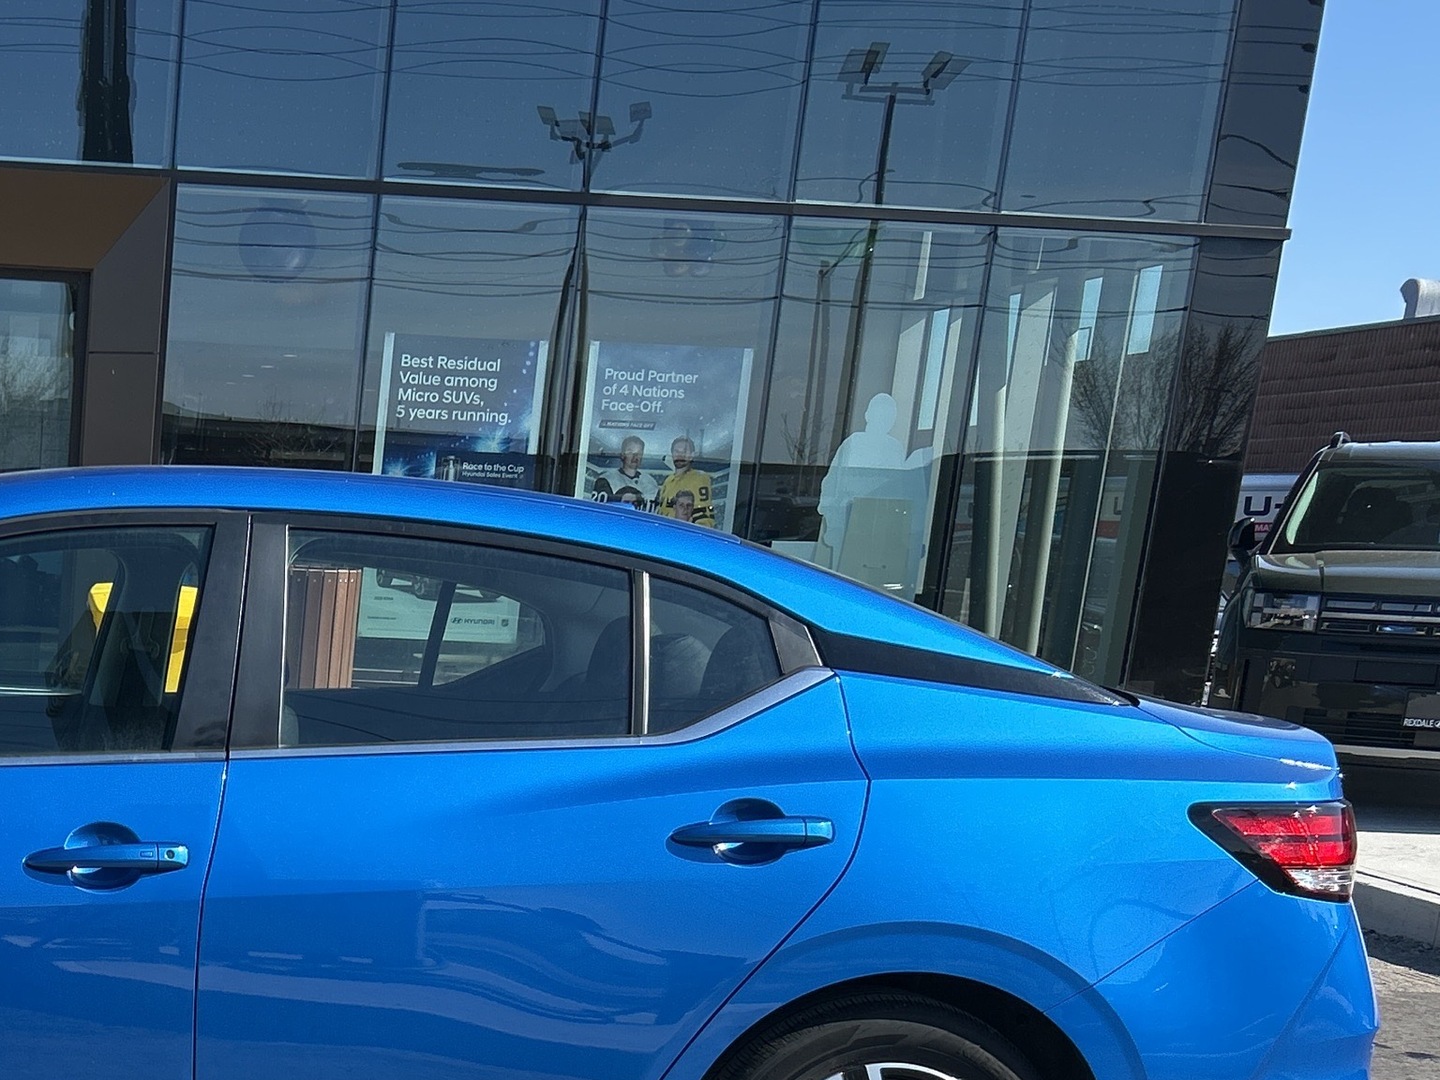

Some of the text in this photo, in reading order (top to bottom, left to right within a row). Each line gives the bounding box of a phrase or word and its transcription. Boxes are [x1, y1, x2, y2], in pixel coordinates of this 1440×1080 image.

[401, 354, 502, 372] Best Residual
[399, 371, 498, 392] Value among
[604, 368, 699, 384] Proud Partner
[398, 388, 484, 407] Micro SUVs,
[602, 384, 685, 399] of 4 Nations
[395, 404, 512, 425] 5 years running.
[601, 399, 664, 414] Face-Off.
[462, 462, 524, 473] Race to the Cup
[1403, 718, 1434, 728] REXDALE
